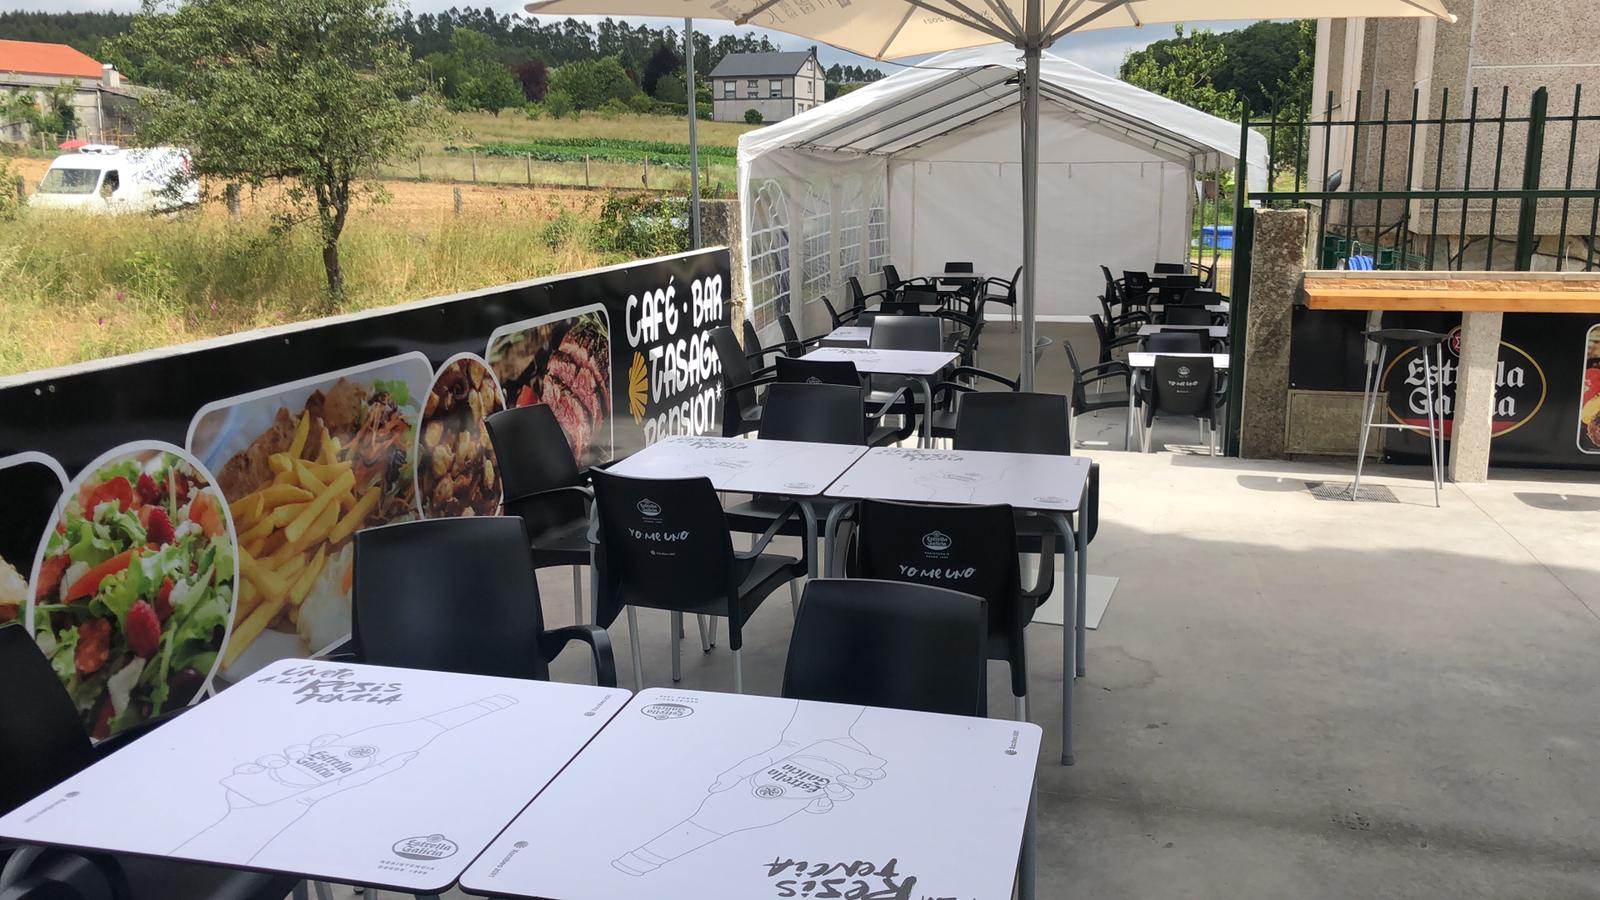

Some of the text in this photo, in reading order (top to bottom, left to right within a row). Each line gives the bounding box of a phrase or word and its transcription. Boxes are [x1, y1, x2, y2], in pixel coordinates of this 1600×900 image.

[625, 274, 723, 348] CAFÉ BAR
[1404, 358, 1525, 388] Estla
[628, 527, 642, 539] YO
[663, 530, 690, 541] UNO
[899, 564, 919, 577] YO
[945, 567, 977, 579] UNO
[296, 760, 335, 778] Galicia
[308, 750, 353, 774] Estrella
[767, 768, 823, 793] Estrella
[782, 763, 831, 786] Galicia
[402, 845, 444, 857] Galicia
[405, 839, 452, 851] Estrella
